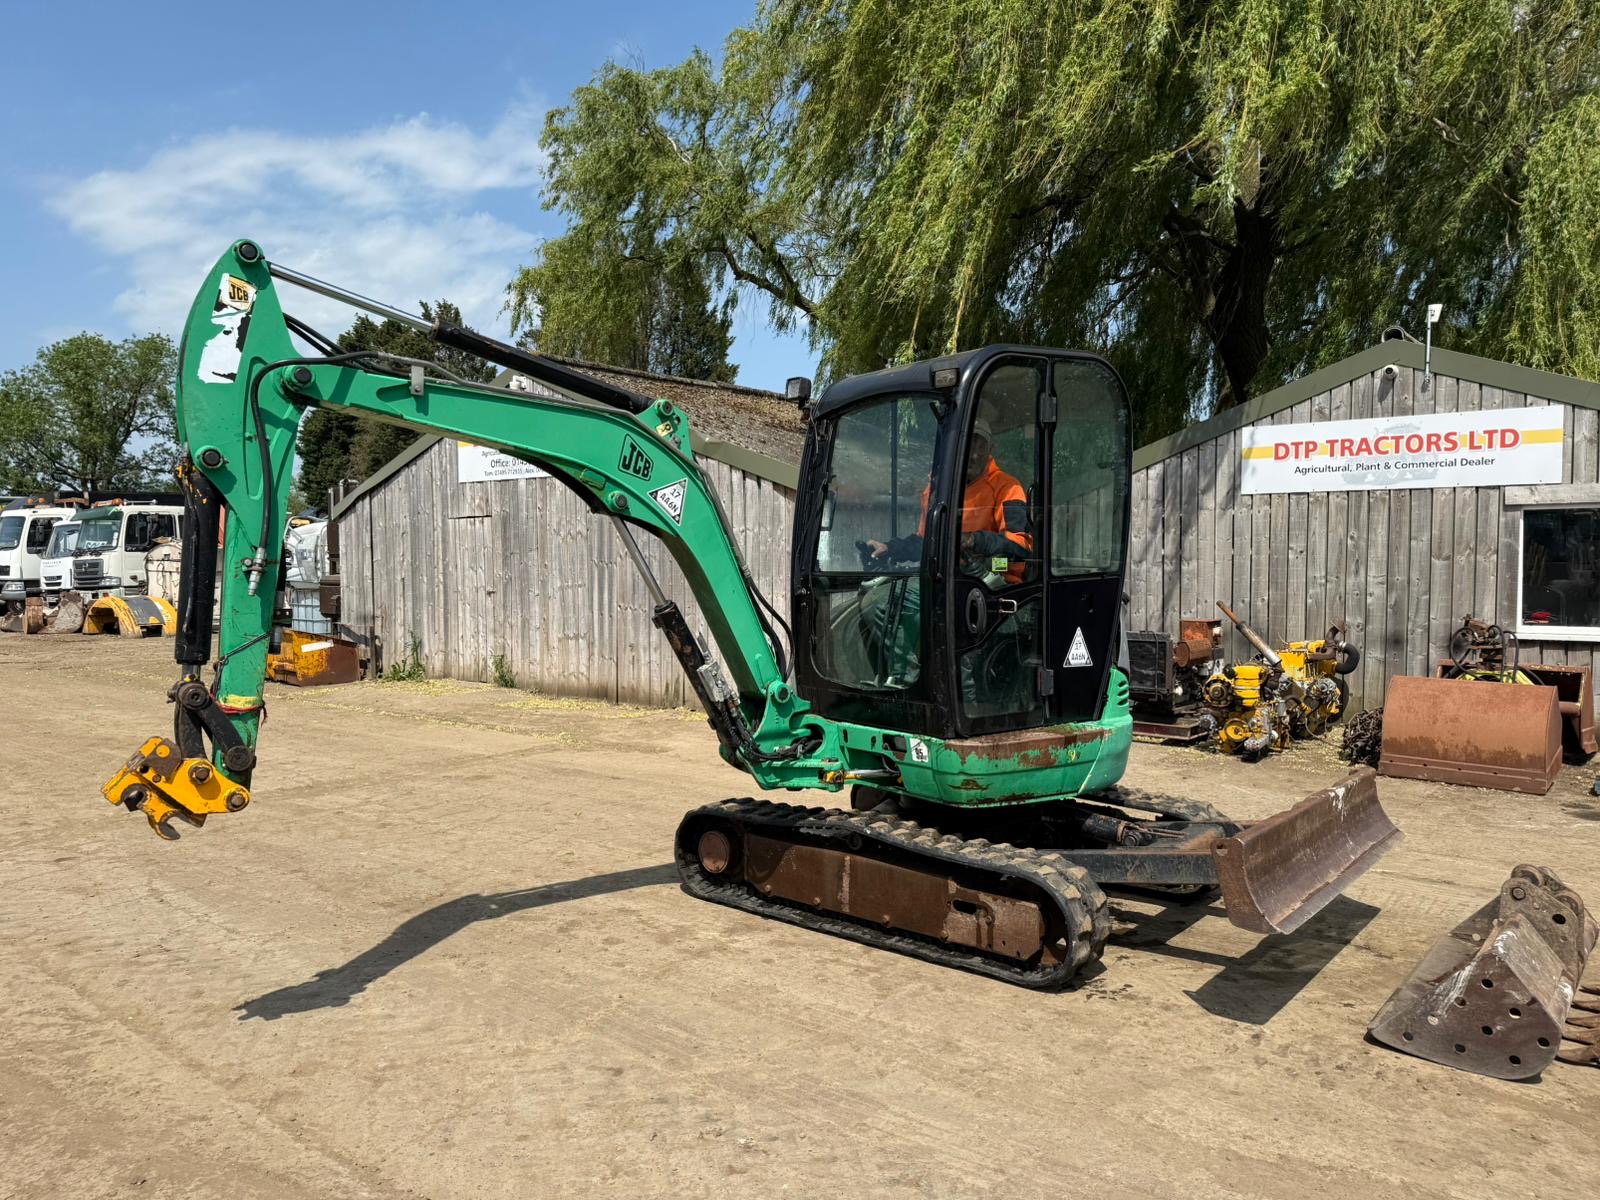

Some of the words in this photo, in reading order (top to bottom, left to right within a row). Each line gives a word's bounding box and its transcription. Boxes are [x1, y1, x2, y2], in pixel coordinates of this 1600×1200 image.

[229, 283, 249, 301] JCB
[1273, 440, 1318, 461] DTP
[1326, 431, 1458, 458] TRACTORS
[1468, 428, 1520, 450] LTD
[491, 458, 510, 468] Office:
[621, 441, 652, 479] JCB
[1294, 463, 1352, 476] Agricultural,
[1355, 462, 1381, 472] Plant
[1383, 461, 1391, 471] &
[1394, 458, 1457, 470] Commercial
[1460, 456, 1496, 467] Dealer
[659, 492, 680, 513] AA6N
[669, 488, 682, 499] 17
